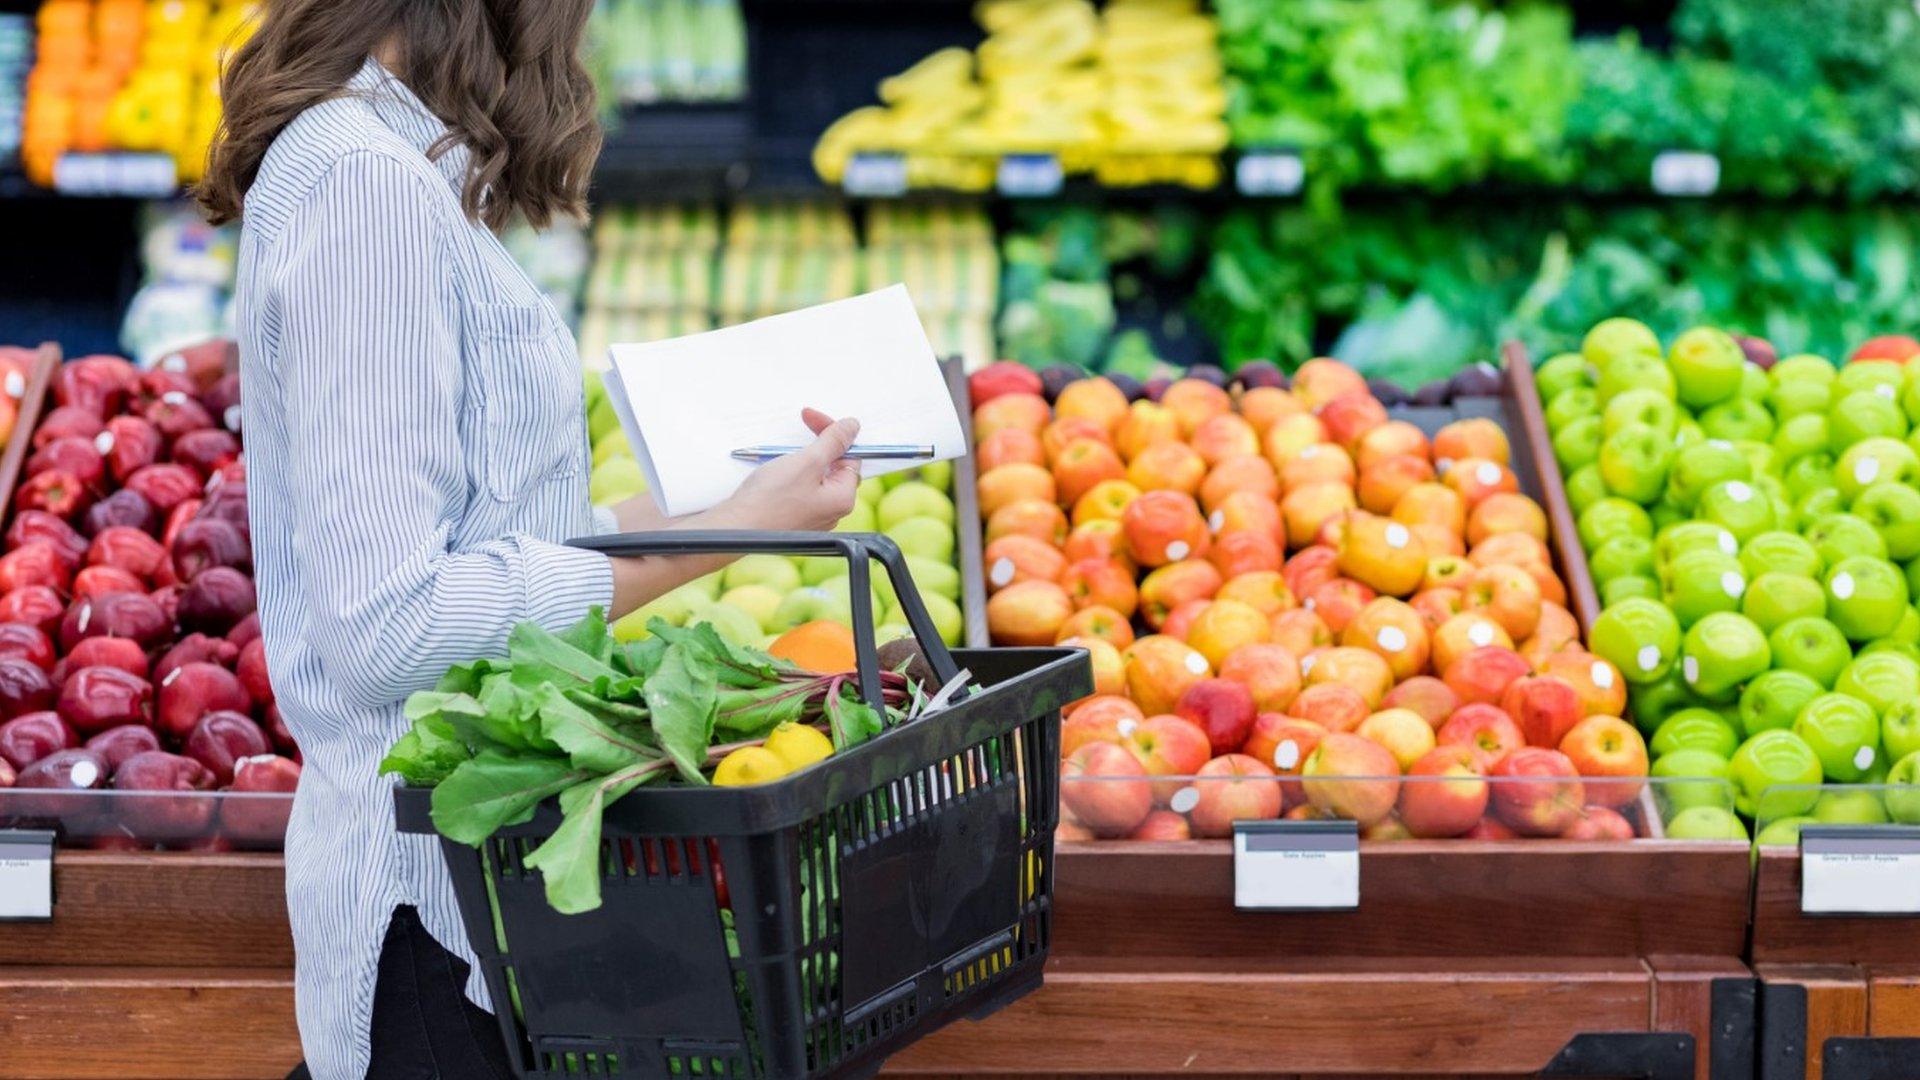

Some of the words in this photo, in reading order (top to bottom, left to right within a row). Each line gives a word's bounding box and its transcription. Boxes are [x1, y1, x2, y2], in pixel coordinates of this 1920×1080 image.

[1301, 849, 1326, 860] Apples
[1851, 852, 1871, 861] Smith
[1874, 852, 1898, 863] Apples
[5, 860, 29, 868] Apples
